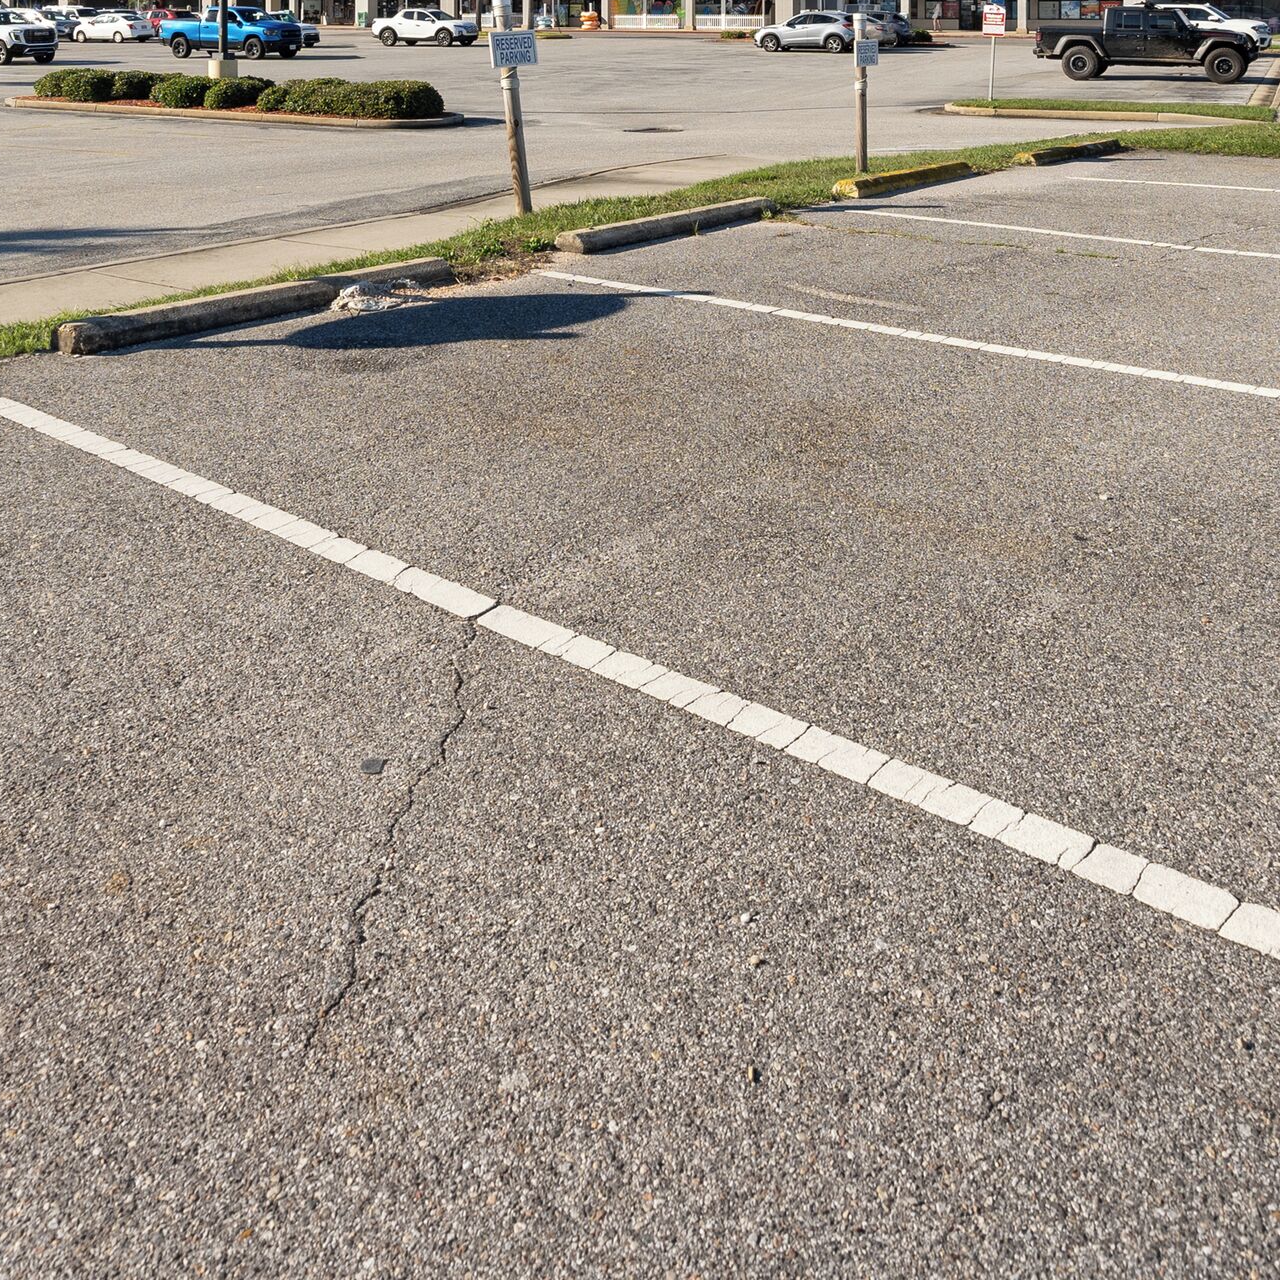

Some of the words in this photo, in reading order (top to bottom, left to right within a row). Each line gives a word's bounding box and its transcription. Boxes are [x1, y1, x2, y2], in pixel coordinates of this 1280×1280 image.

[495, 35, 533, 51] RESERVED
[500, 49, 532, 64] PARKING
[860, 54, 876, 64] PARKING
